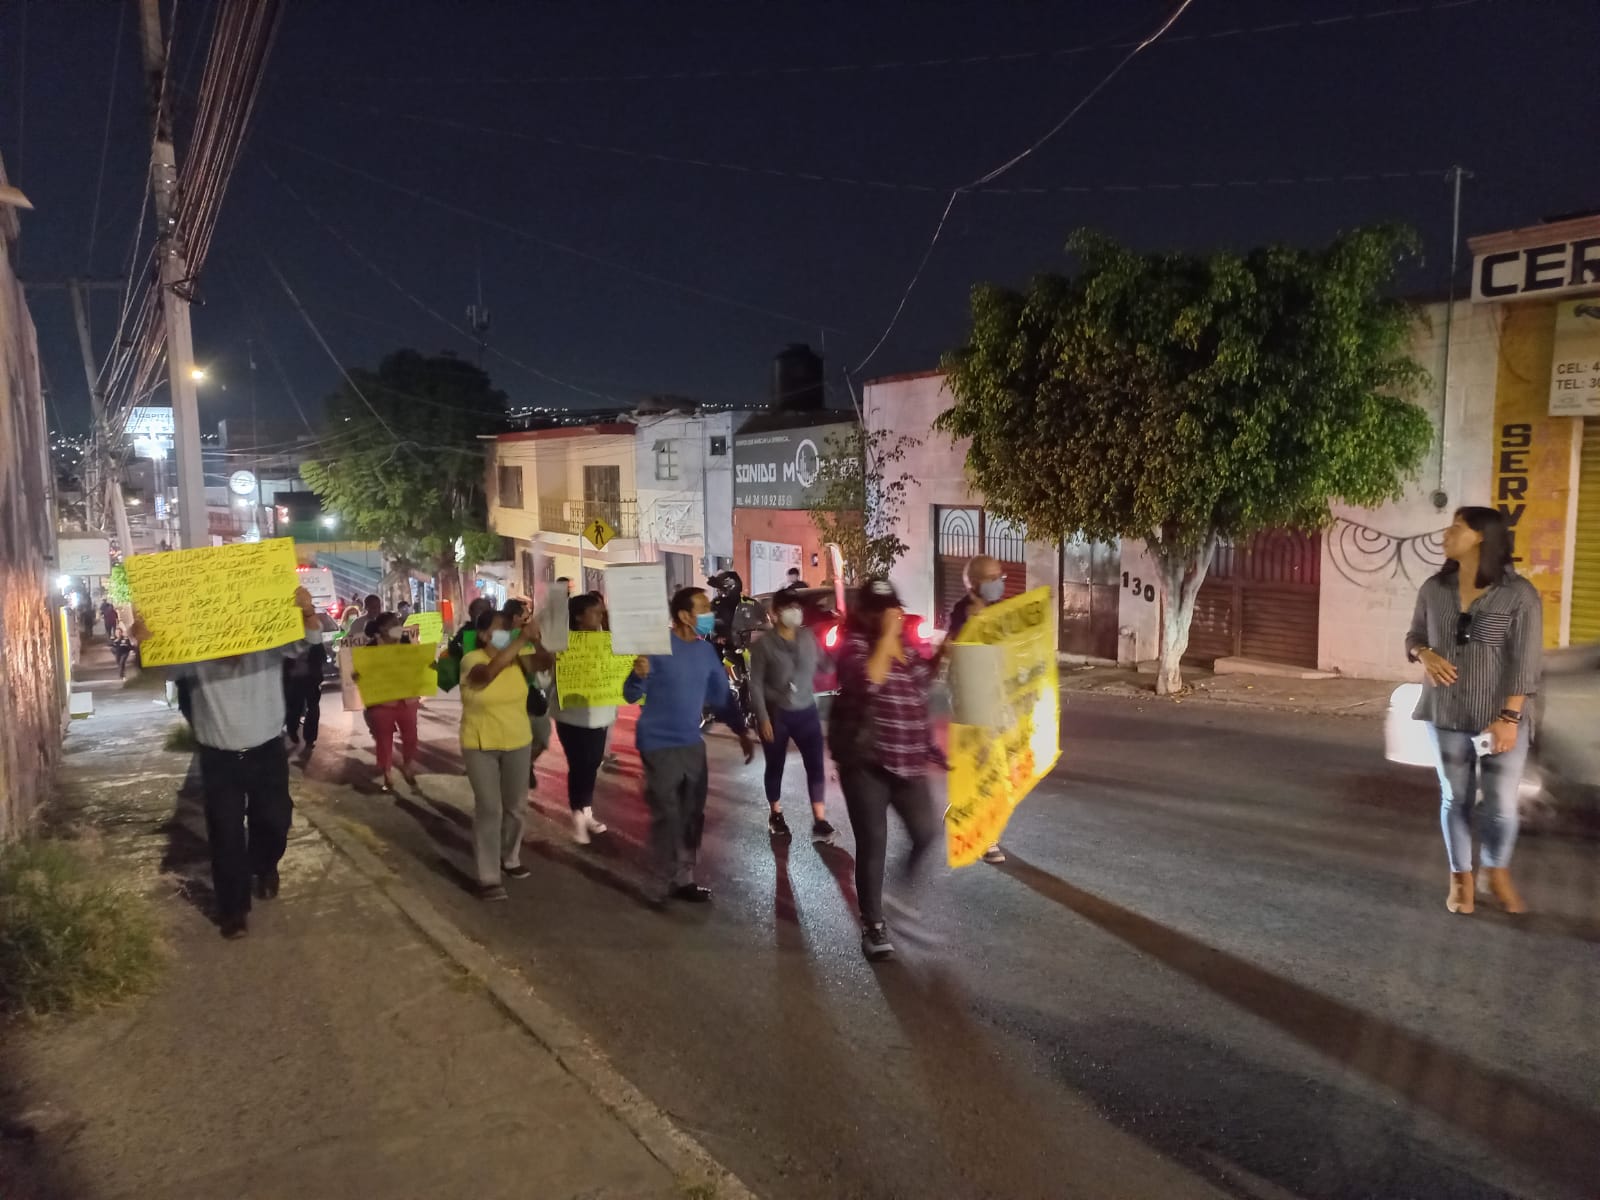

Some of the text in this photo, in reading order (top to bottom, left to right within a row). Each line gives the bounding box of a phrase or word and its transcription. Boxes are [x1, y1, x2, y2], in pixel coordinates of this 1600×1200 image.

[1555, 379, 1586, 391] TEL:
[736, 462, 777, 483] SONIDO
[126, 556, 160, 572] LOS
[1122, 571, 1155, 602] 130
